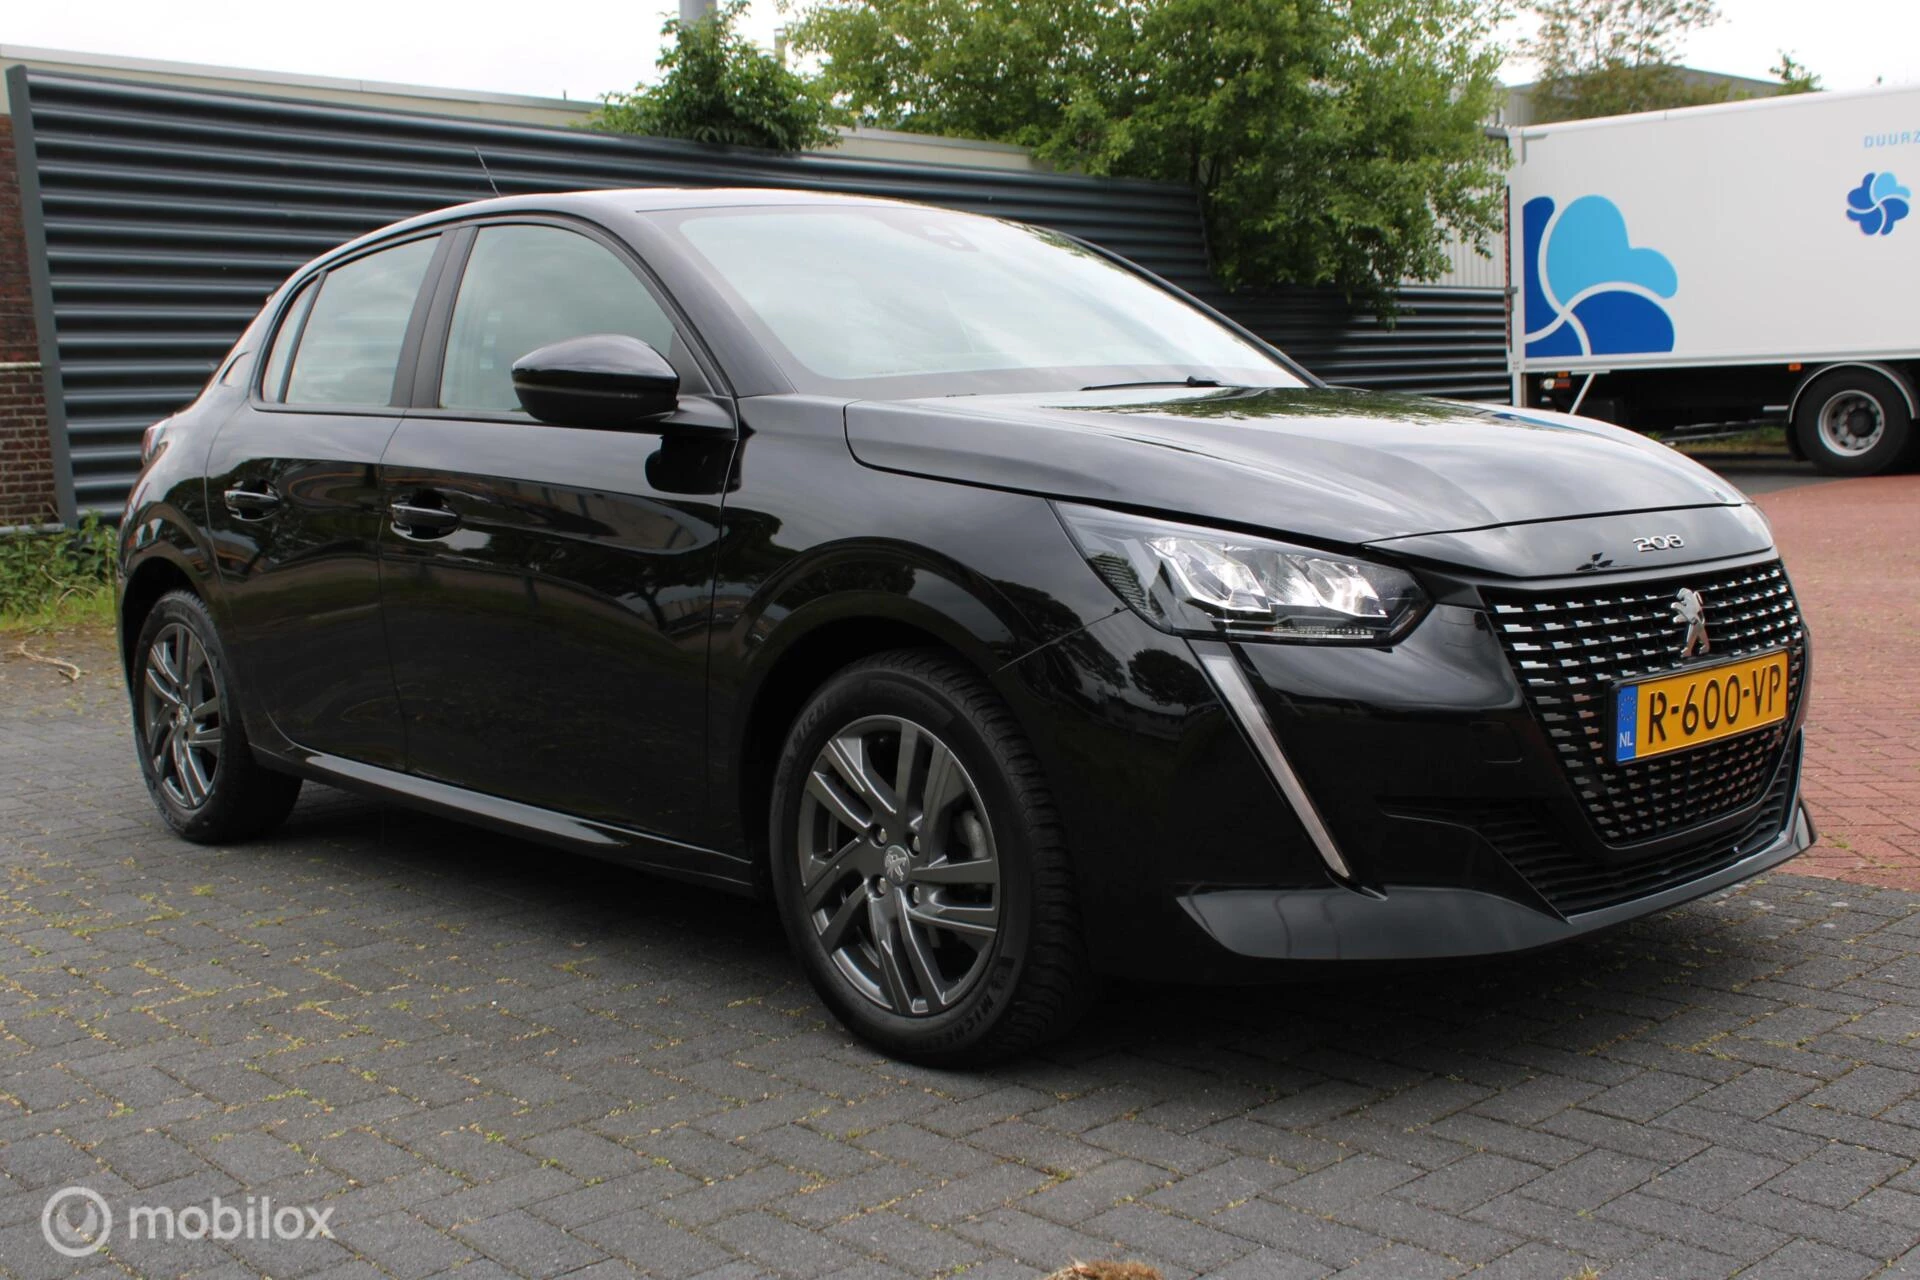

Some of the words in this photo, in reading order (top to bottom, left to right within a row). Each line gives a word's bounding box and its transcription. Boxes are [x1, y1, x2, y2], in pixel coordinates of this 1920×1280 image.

[1633, 534, 1685, 552] 208
[1648, 663, 1782, 744] R-600-VP
[1619, 730, 1634, 749] NL
[919, 992, 996, 1048] MICHEL
